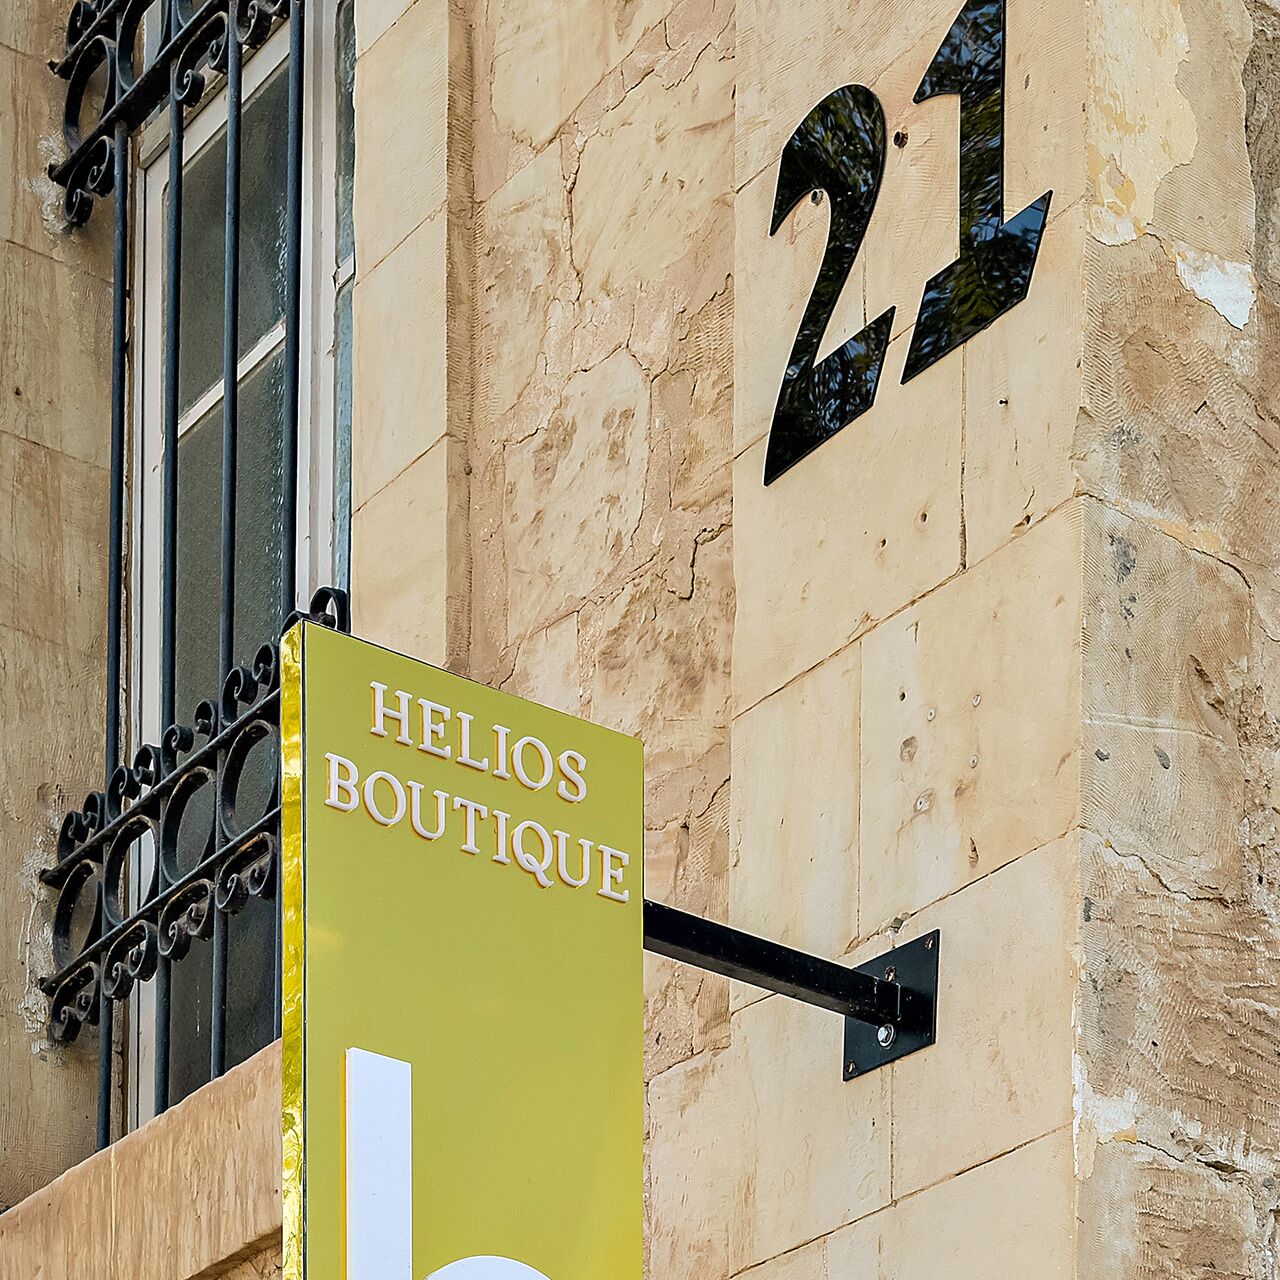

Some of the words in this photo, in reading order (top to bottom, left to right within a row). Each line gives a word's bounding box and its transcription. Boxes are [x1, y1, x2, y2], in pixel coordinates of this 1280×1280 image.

[763, 0, 1054, 487] 21
[369, 680, 588, 803] HELIOS
[323, 752, 630, 903] BOUTIQUE
